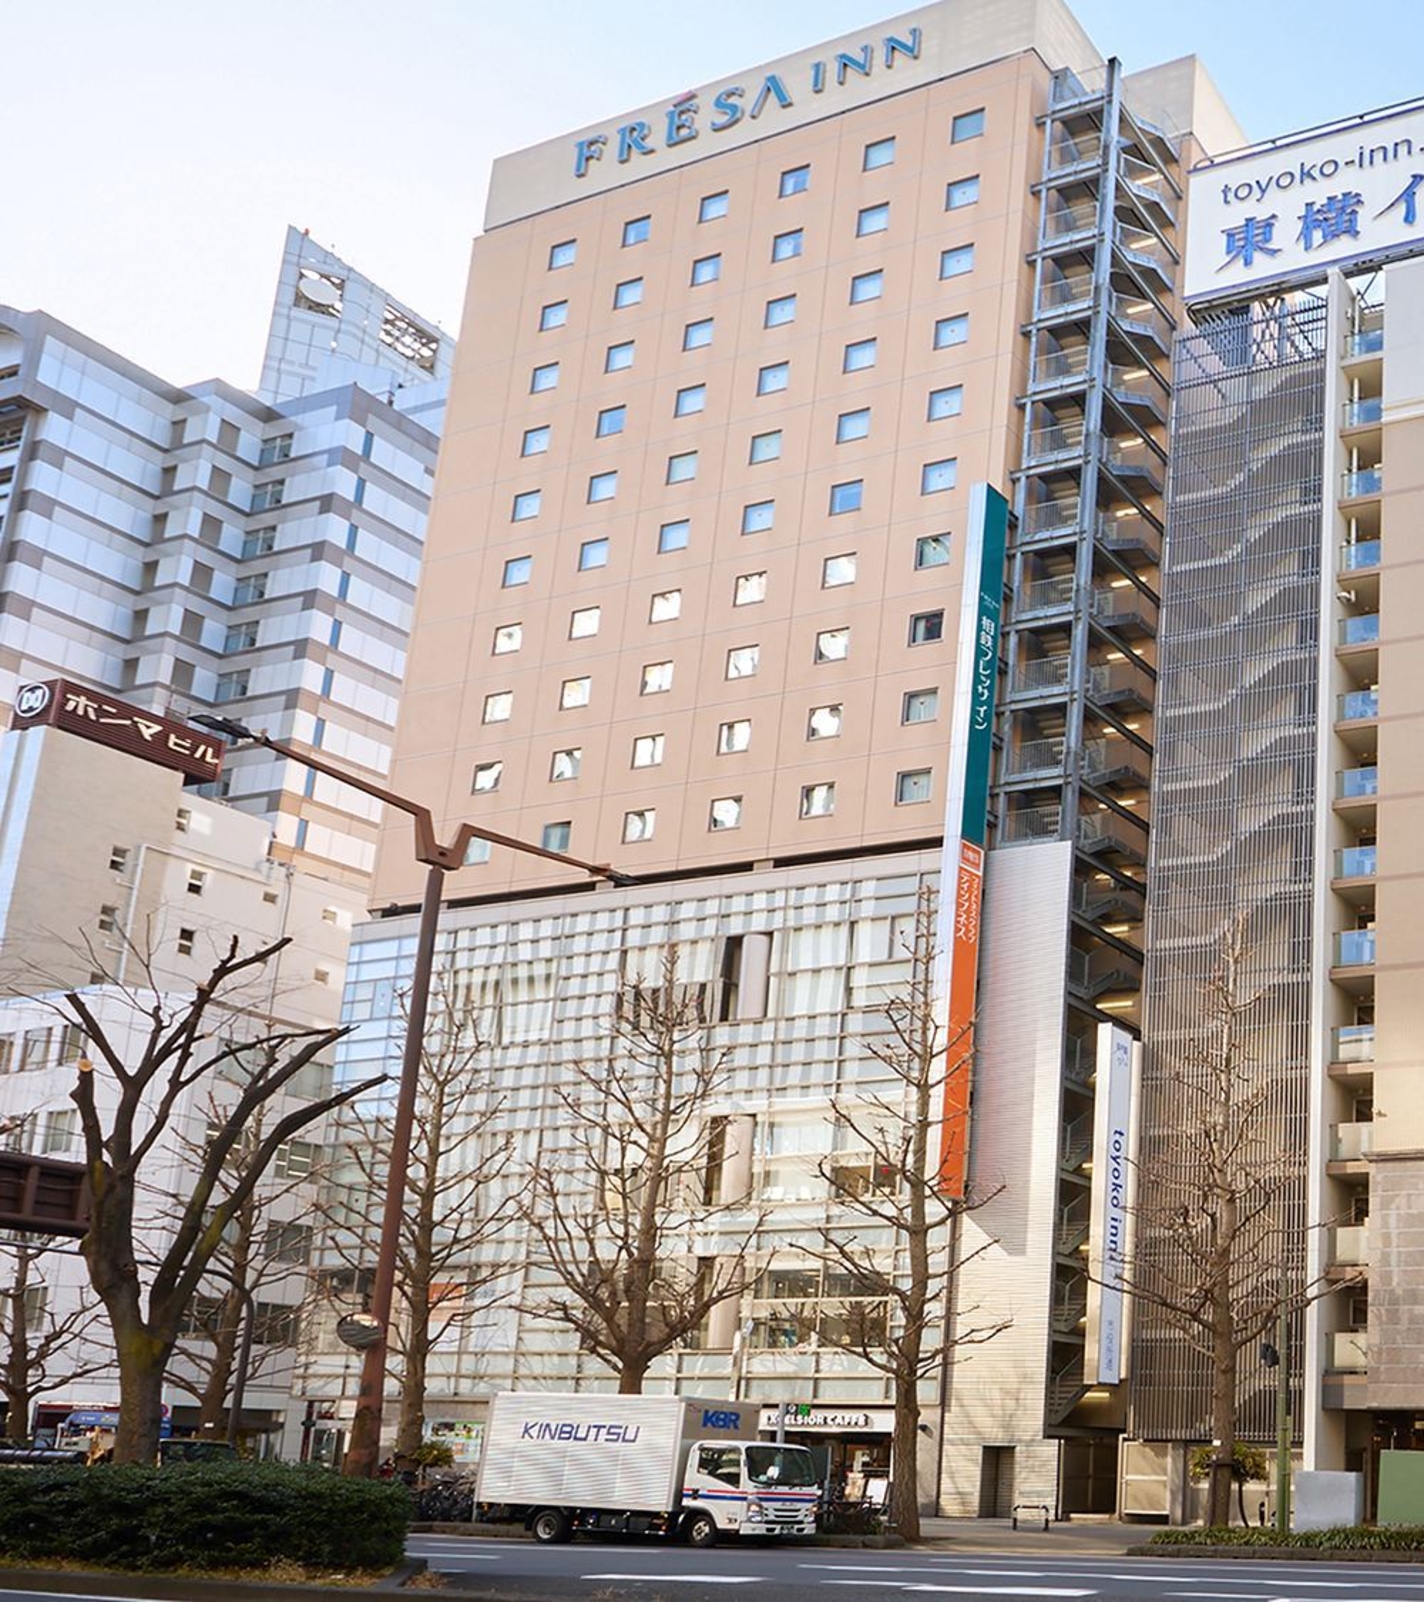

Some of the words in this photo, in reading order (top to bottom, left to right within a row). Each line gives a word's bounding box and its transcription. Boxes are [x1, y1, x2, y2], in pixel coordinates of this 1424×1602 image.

[811, 27, 922, 93] INN
[65, 693, 220, 764] ホンマビル
[1110, 1129, 1125, 1208] toyoko
[1109, 1217, 1122, 1252] inn
[521, 1422, 640, 1443] KINBUTSU
